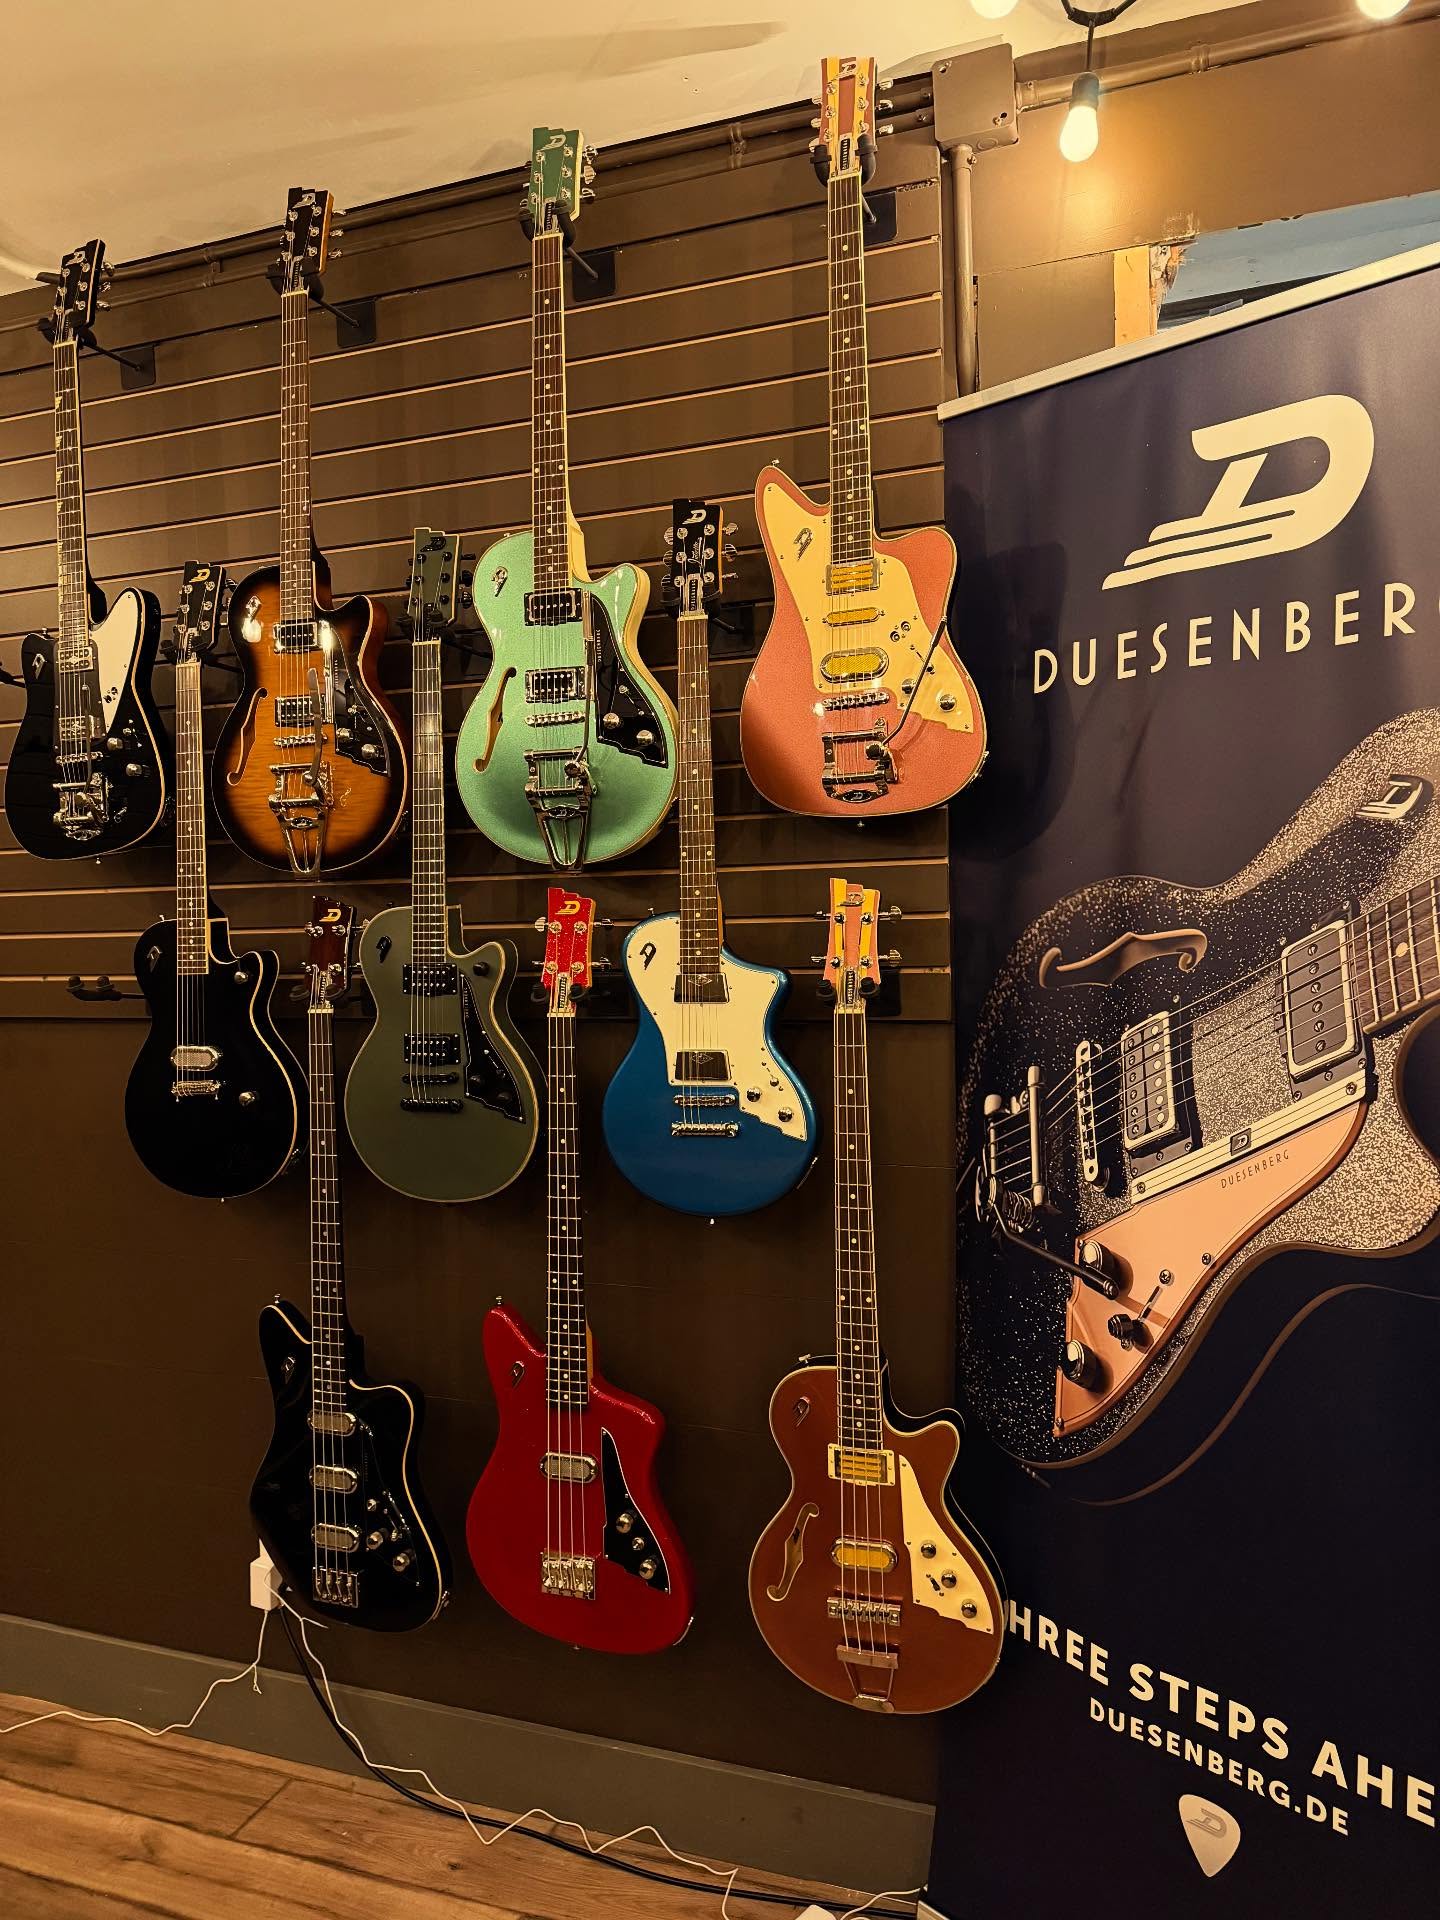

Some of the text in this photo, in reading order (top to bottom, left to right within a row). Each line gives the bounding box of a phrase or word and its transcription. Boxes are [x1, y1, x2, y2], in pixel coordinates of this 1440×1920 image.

[1033, 582, 1440, 694] DUESENBER
[1220, 1149, 1289, 1189] DUESENBERG
[1008, 1599, 1435, 1828] HREE STEPS AHE
[1090, 1696, 1349, 1836] DUESENBERG.DE
